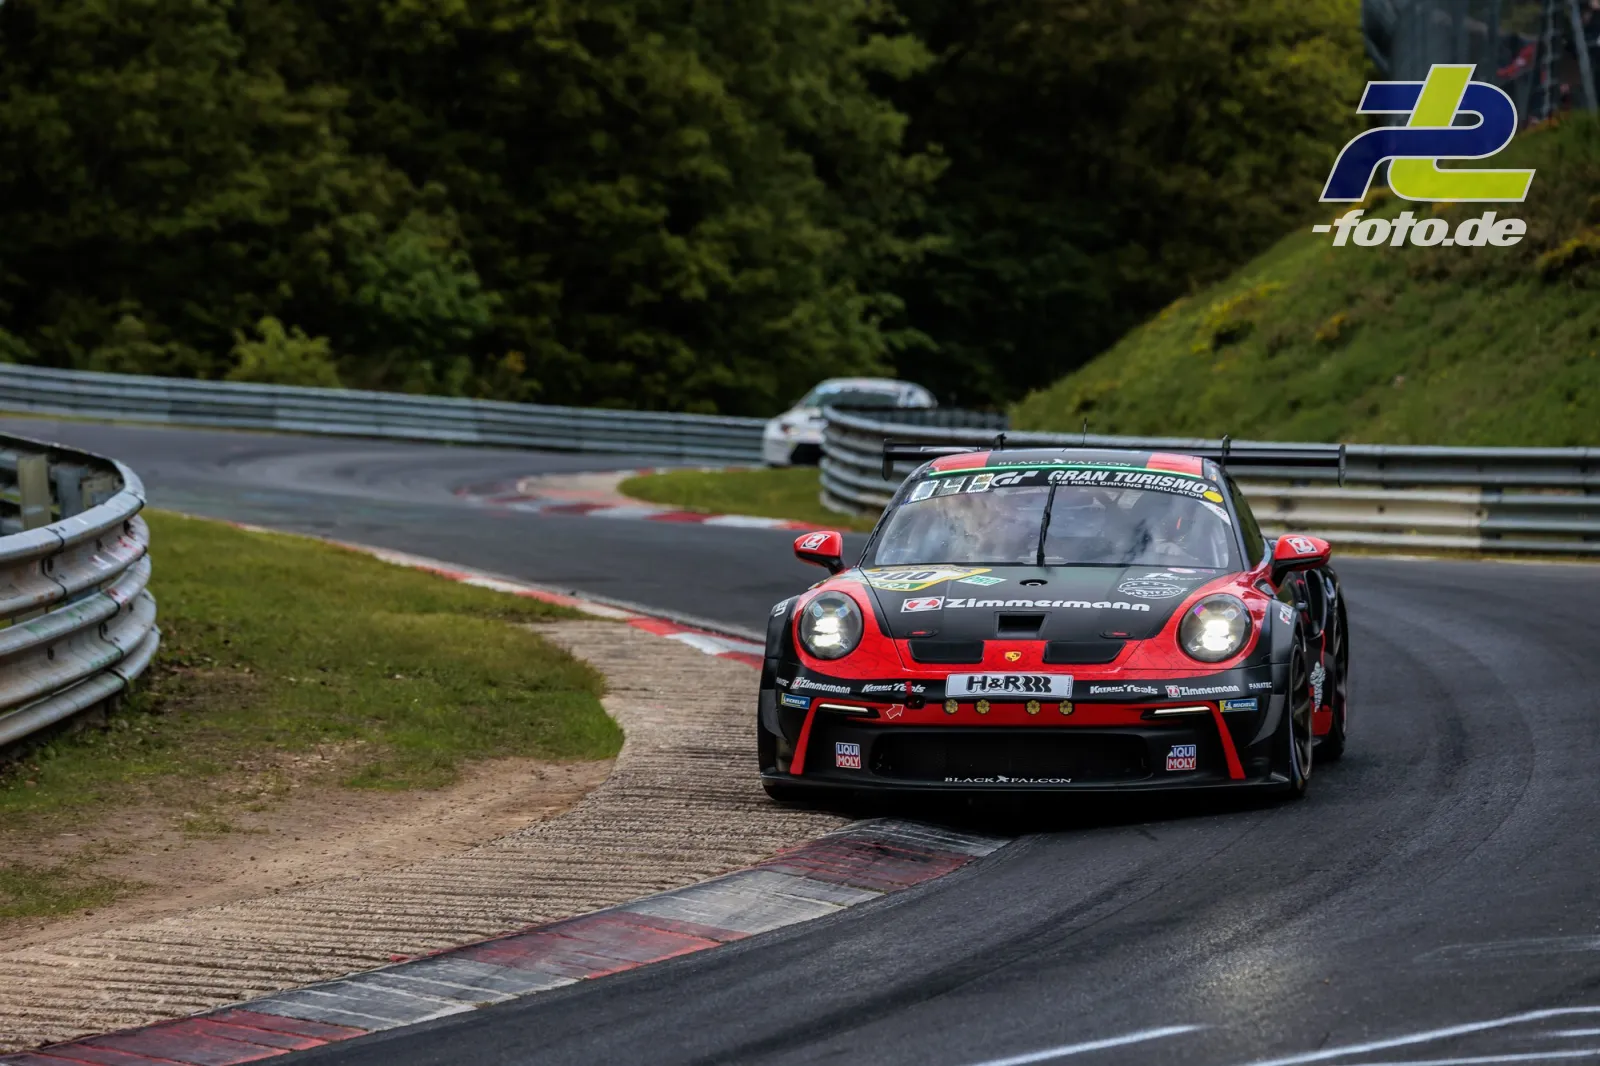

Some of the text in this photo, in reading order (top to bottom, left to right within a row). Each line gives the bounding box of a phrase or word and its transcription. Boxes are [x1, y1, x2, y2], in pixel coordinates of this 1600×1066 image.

[1047, 470, 1209, 494] GRAN TURISMO
[1100, 480, 1142, 489] DRIVING
[1144, 485, 1203, 499] SIMULATOR
[945, 598, 1150, 611] Zimmermann
[800, 680, 851, 694] Zimmermann
[893, 683, 926, 693] Tols
[1180, 685, 1240, 695] Zimmermann
[837, 744, 858, 756] LIQUI
[1170, 747, 1194, 757] IQUI
[838, 756, 859, 767] MOLY
[1168, 758, 1195, 769] MOLY
